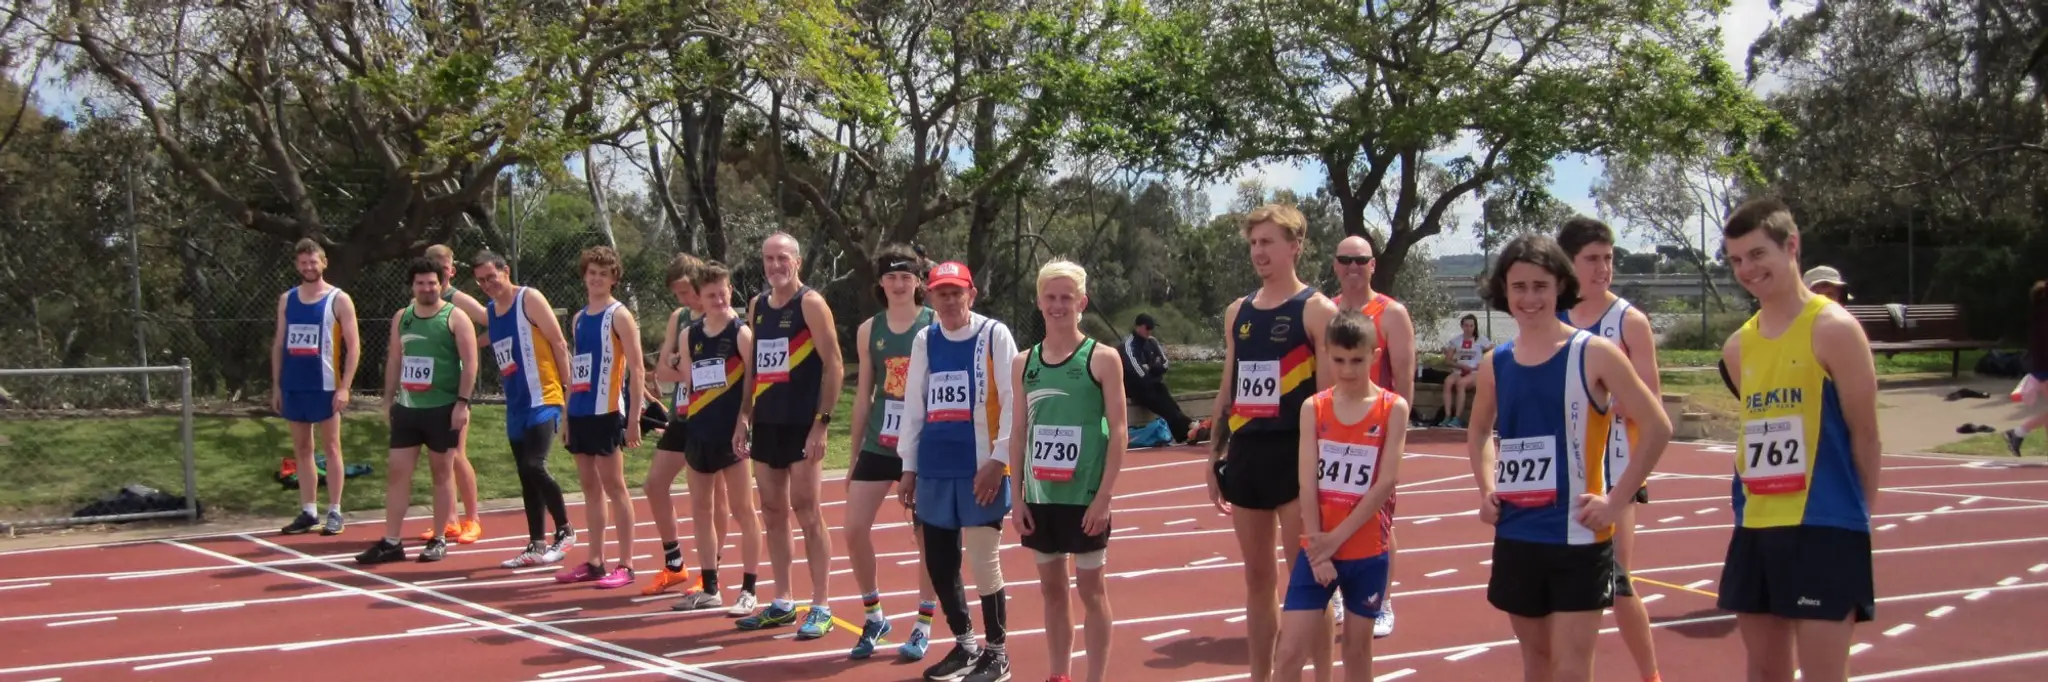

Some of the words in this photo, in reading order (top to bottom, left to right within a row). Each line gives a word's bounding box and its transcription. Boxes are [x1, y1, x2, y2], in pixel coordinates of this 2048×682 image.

[289, 333, 317, 345] 3741
[600, 313, 612, 396] CHILWELL
[404, 366, 431, 379] 1169
[976, 340, 985, 404] CHILWELL
[932, 386, 966, 405] 1485
[1237, 377, 1277, 397] 1969
[1746, 387, 1802, 409] DEAKIN
[1034, 441, 1078, 462] 2730
[1748, 439, 1799, 468] 762
[1316, 458, 1372, 487] 3415
[1498, 457, 1552, 484] 2927
